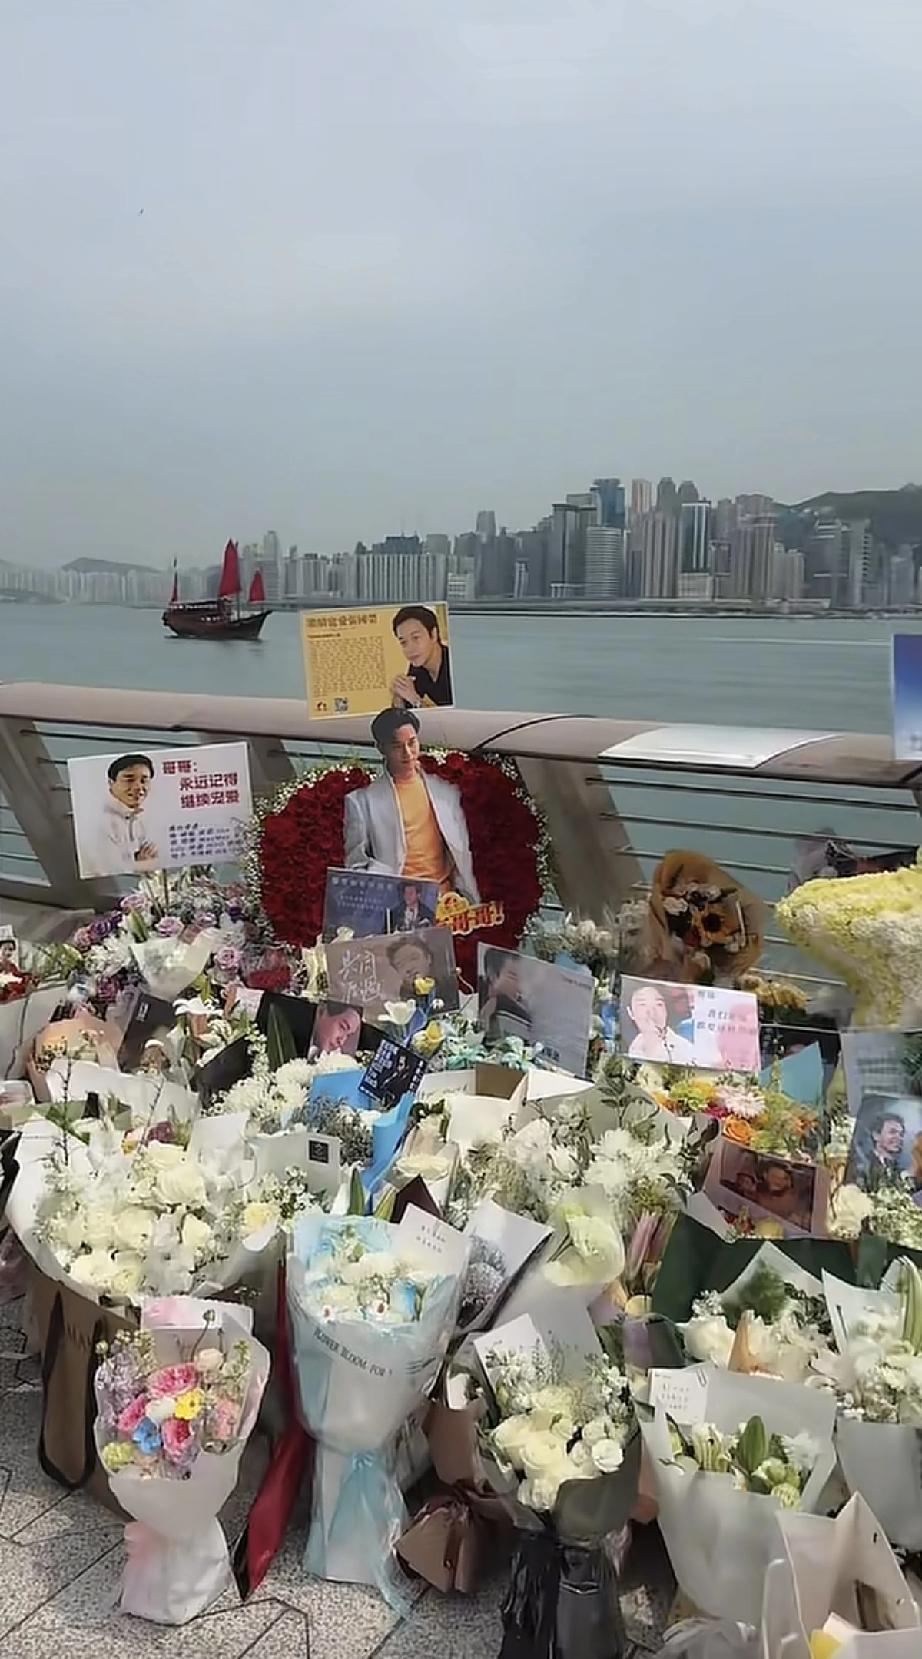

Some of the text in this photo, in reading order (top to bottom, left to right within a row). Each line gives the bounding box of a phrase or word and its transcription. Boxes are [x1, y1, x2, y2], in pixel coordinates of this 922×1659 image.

[179, 772, 239, 791] 永远记得
[180, 790, 241, 809] 继续宠爱
[340, 1345, 368, 1370] BLOOM
[369, 1363, 386, 1377] FOR
